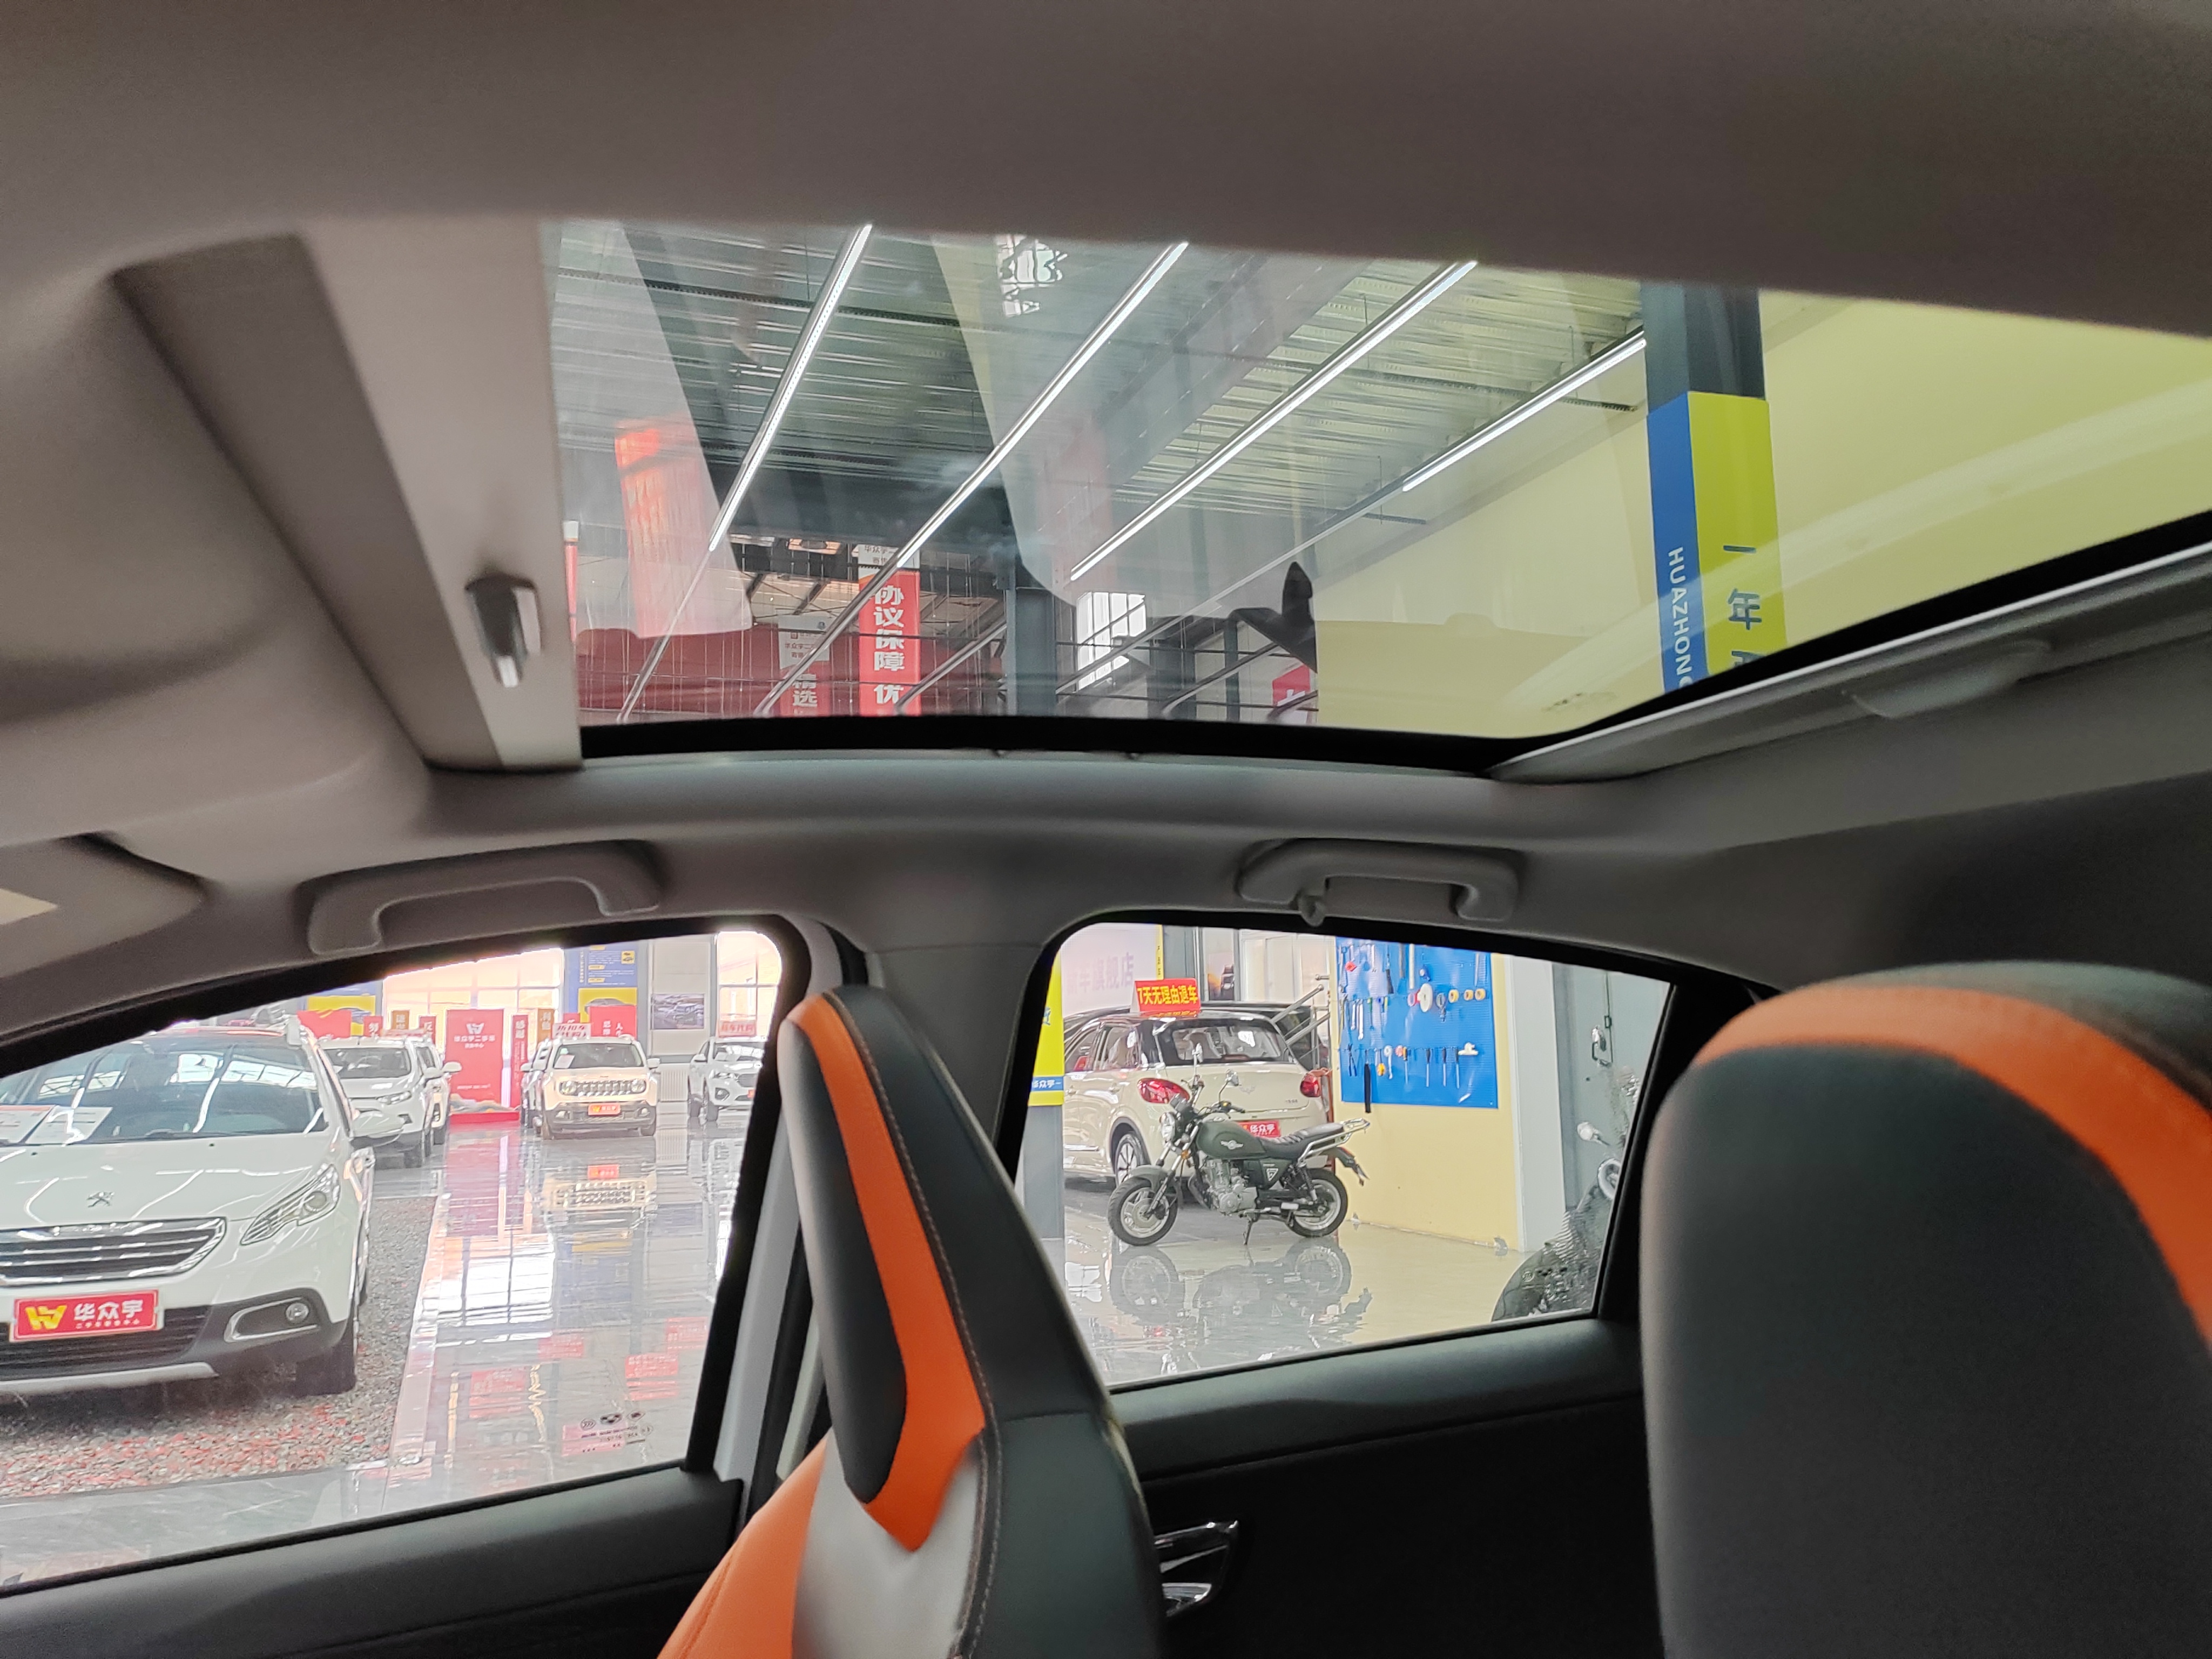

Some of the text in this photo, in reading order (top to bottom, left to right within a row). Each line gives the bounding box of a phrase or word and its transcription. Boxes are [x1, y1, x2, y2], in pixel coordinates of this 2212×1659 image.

[874, 585, 905, 671] 协议保障
[792, 673, 818, 716] 精选
[1137, 984, 1198, 1005] 7天无理由退车
[74, 1299, 143, 1321] 华众宇
